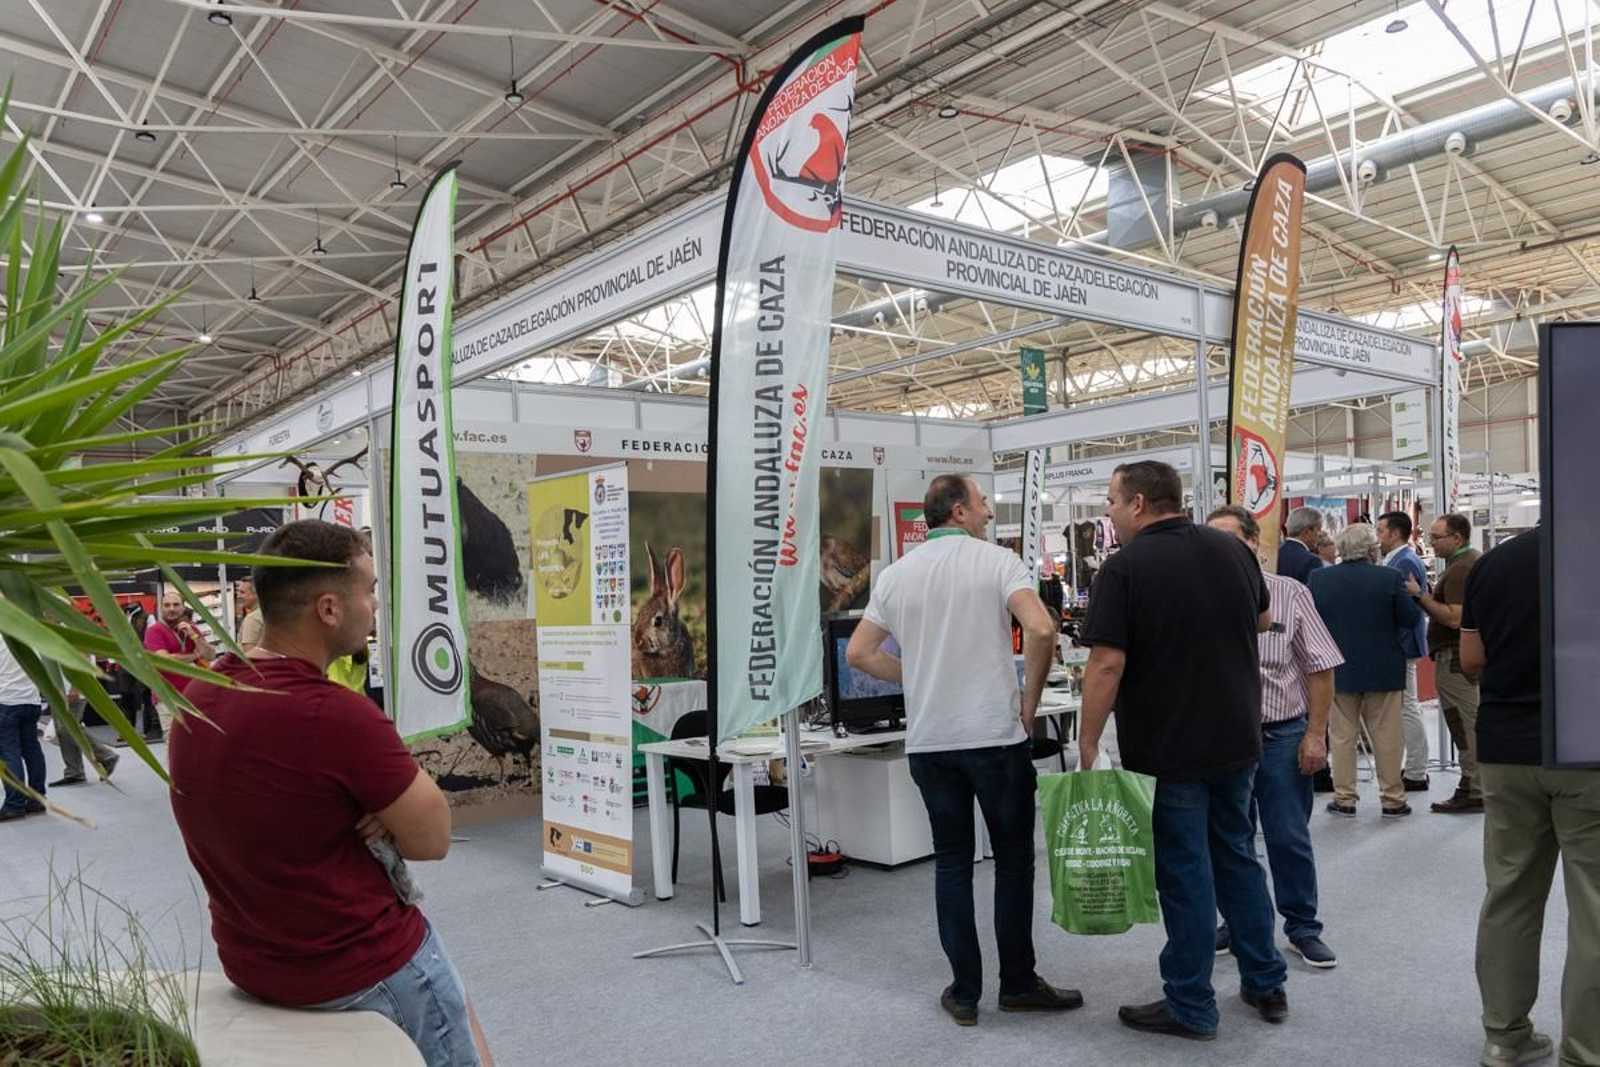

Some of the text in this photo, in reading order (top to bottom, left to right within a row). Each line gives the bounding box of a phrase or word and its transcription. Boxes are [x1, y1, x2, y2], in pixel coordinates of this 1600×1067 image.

[756, 92, 810, 141] ANDALUZA
[809, 77, 825, 96] DE
[840, 211, 946, 253] FEDERACIÓN
[947, 237, 1026, 271] ANDALUZA
[1027, 255, 1050, 275] DE
[451, 342, 477, 365] ALUZA
[477, 336, 489, 355] DE
[577, 265, 646, 311] PROVINCIAL
[646, 254, 665, 280] DE
[667, 235, 702, 271] JAÉN
[946, 259, 1087, 306] PROVINCIAL DE JAÉN
[1259, 177, 1294, 433] ANDALUZA DE CAZA
[1240, 253, 1269, 424] FEDERACIÓN
[1336, 328, 1347, 343] DE
[621, 439, 853, 461] FEDERACIÓ CAZA
[747, 254, 786, 702] FEDERACIÓN ANDALUZA DE CAZA
[926, 454, 974, 465] www.fac.es
